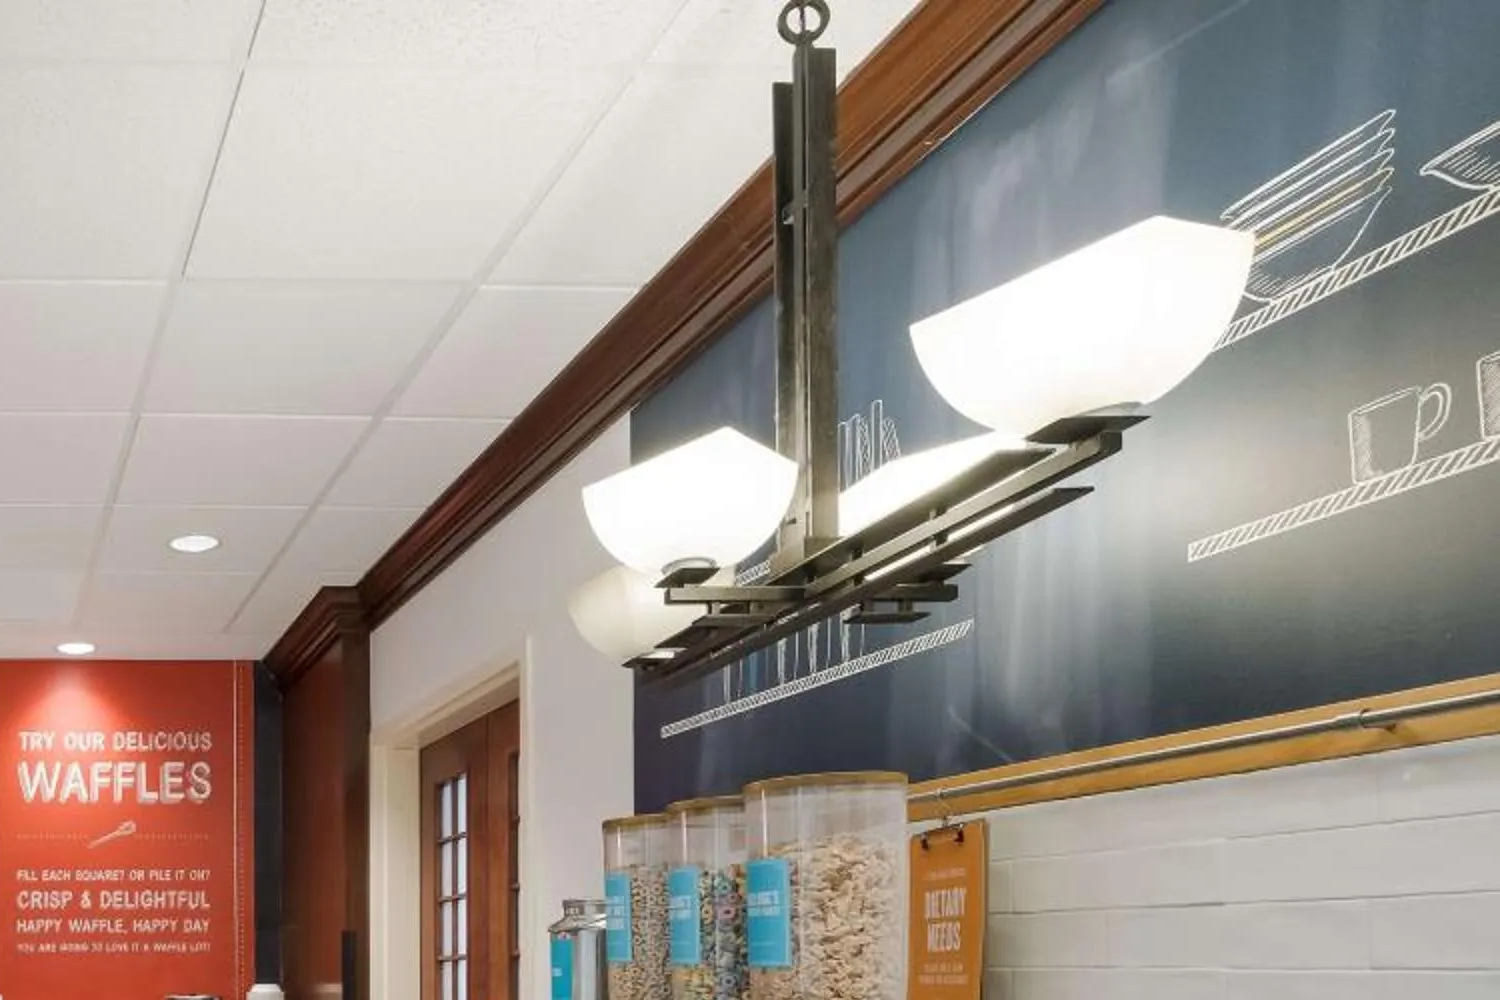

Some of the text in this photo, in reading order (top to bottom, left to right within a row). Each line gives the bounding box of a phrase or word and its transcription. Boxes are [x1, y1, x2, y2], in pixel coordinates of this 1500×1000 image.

[19, 731, 212, 752] TRY OUR DELICIOUS
[17, 761, 212, 804] WAFFLES
[17, 870, 38, 882] FILL
[42, 870, 71, 882] EACH
[129, 870, 145, 882] OR
[149, 870, 171, 882] PILE
[176, 870, 184, 881] IT
[17, 890, 211, 909] CRISP & DELIGHTFUL
[924, 887, 967, 919] DIETARY
[17, 919, 211, 935] HAPPY WAFFLE, HAPPY DAY
[927, 921, 961, 953] NEEDS
